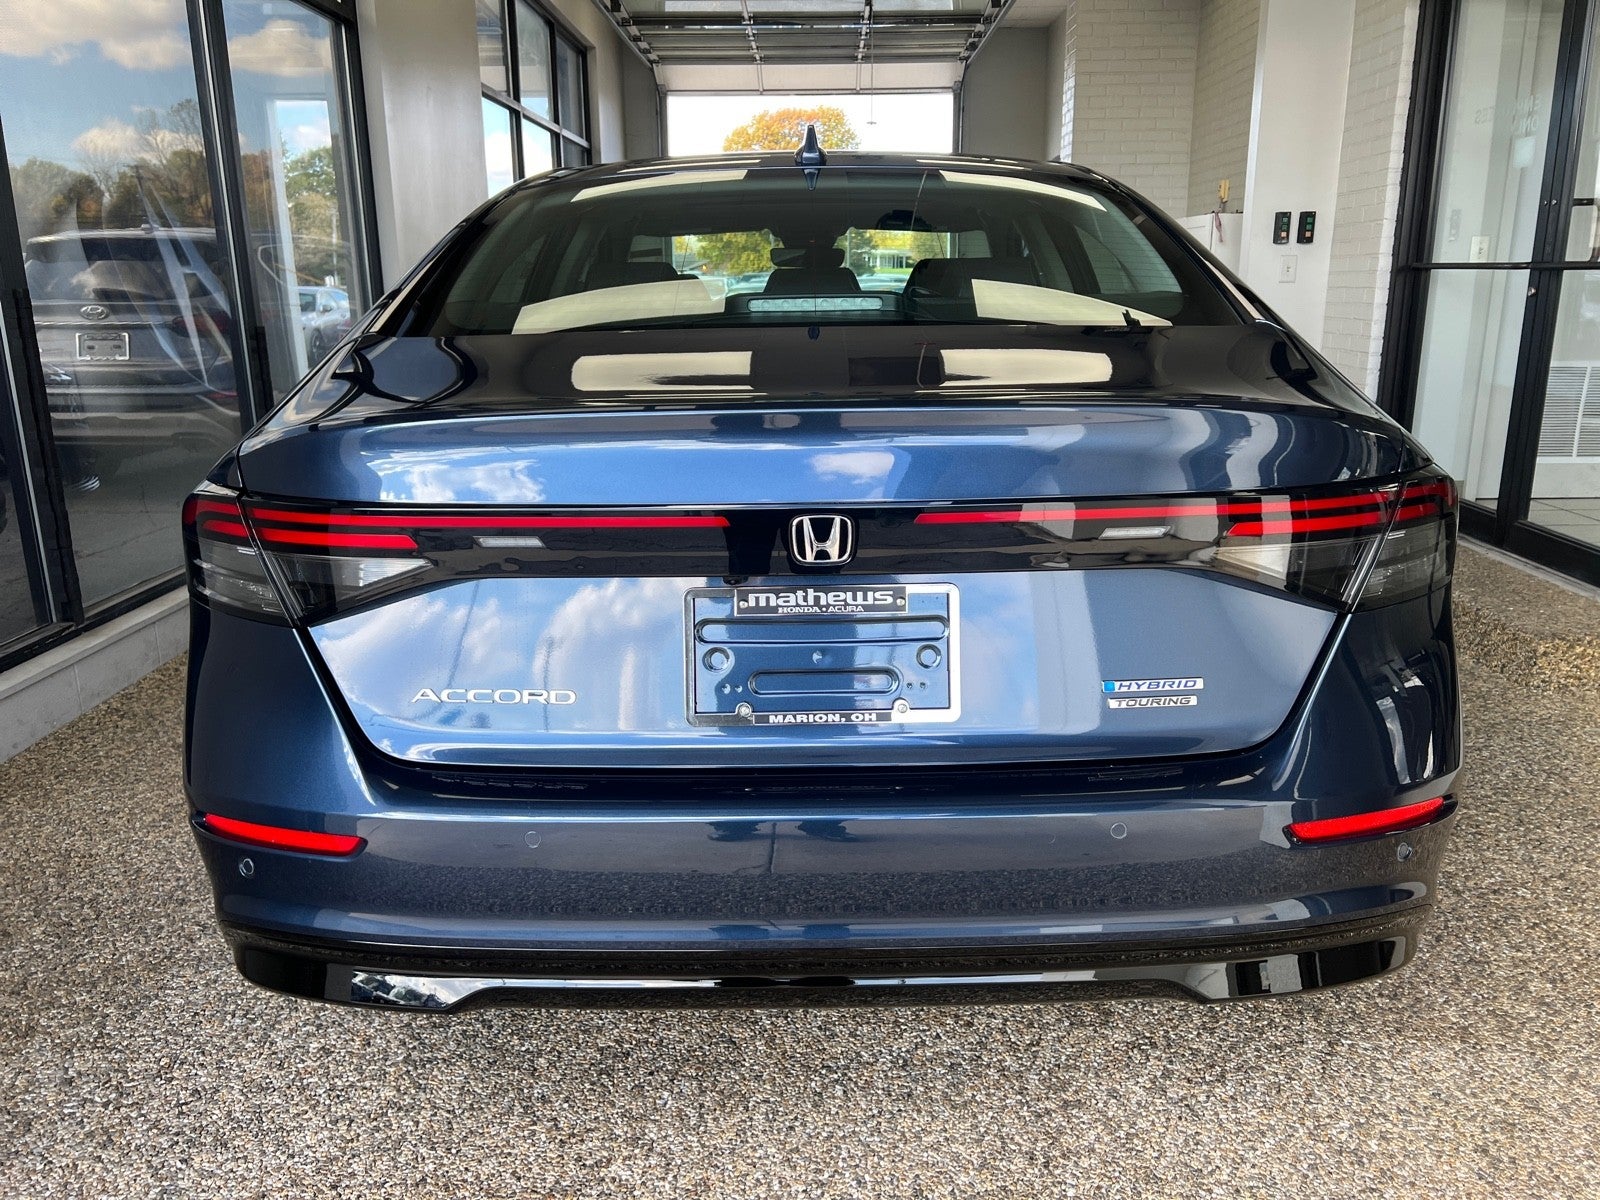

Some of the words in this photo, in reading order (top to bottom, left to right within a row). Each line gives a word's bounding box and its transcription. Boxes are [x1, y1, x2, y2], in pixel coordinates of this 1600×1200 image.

[748, 588, 894, 607] mathews
[827, 605, 864, 613] ACURA
[1117, 679, 1197, 691] HYBRID
[411, 688, 577, 705] ACCORD
[1115, 697, 1191, 707] TOURING
[768, 713, 846, 723] MARION,
[850, 713, 877, 722] OH
